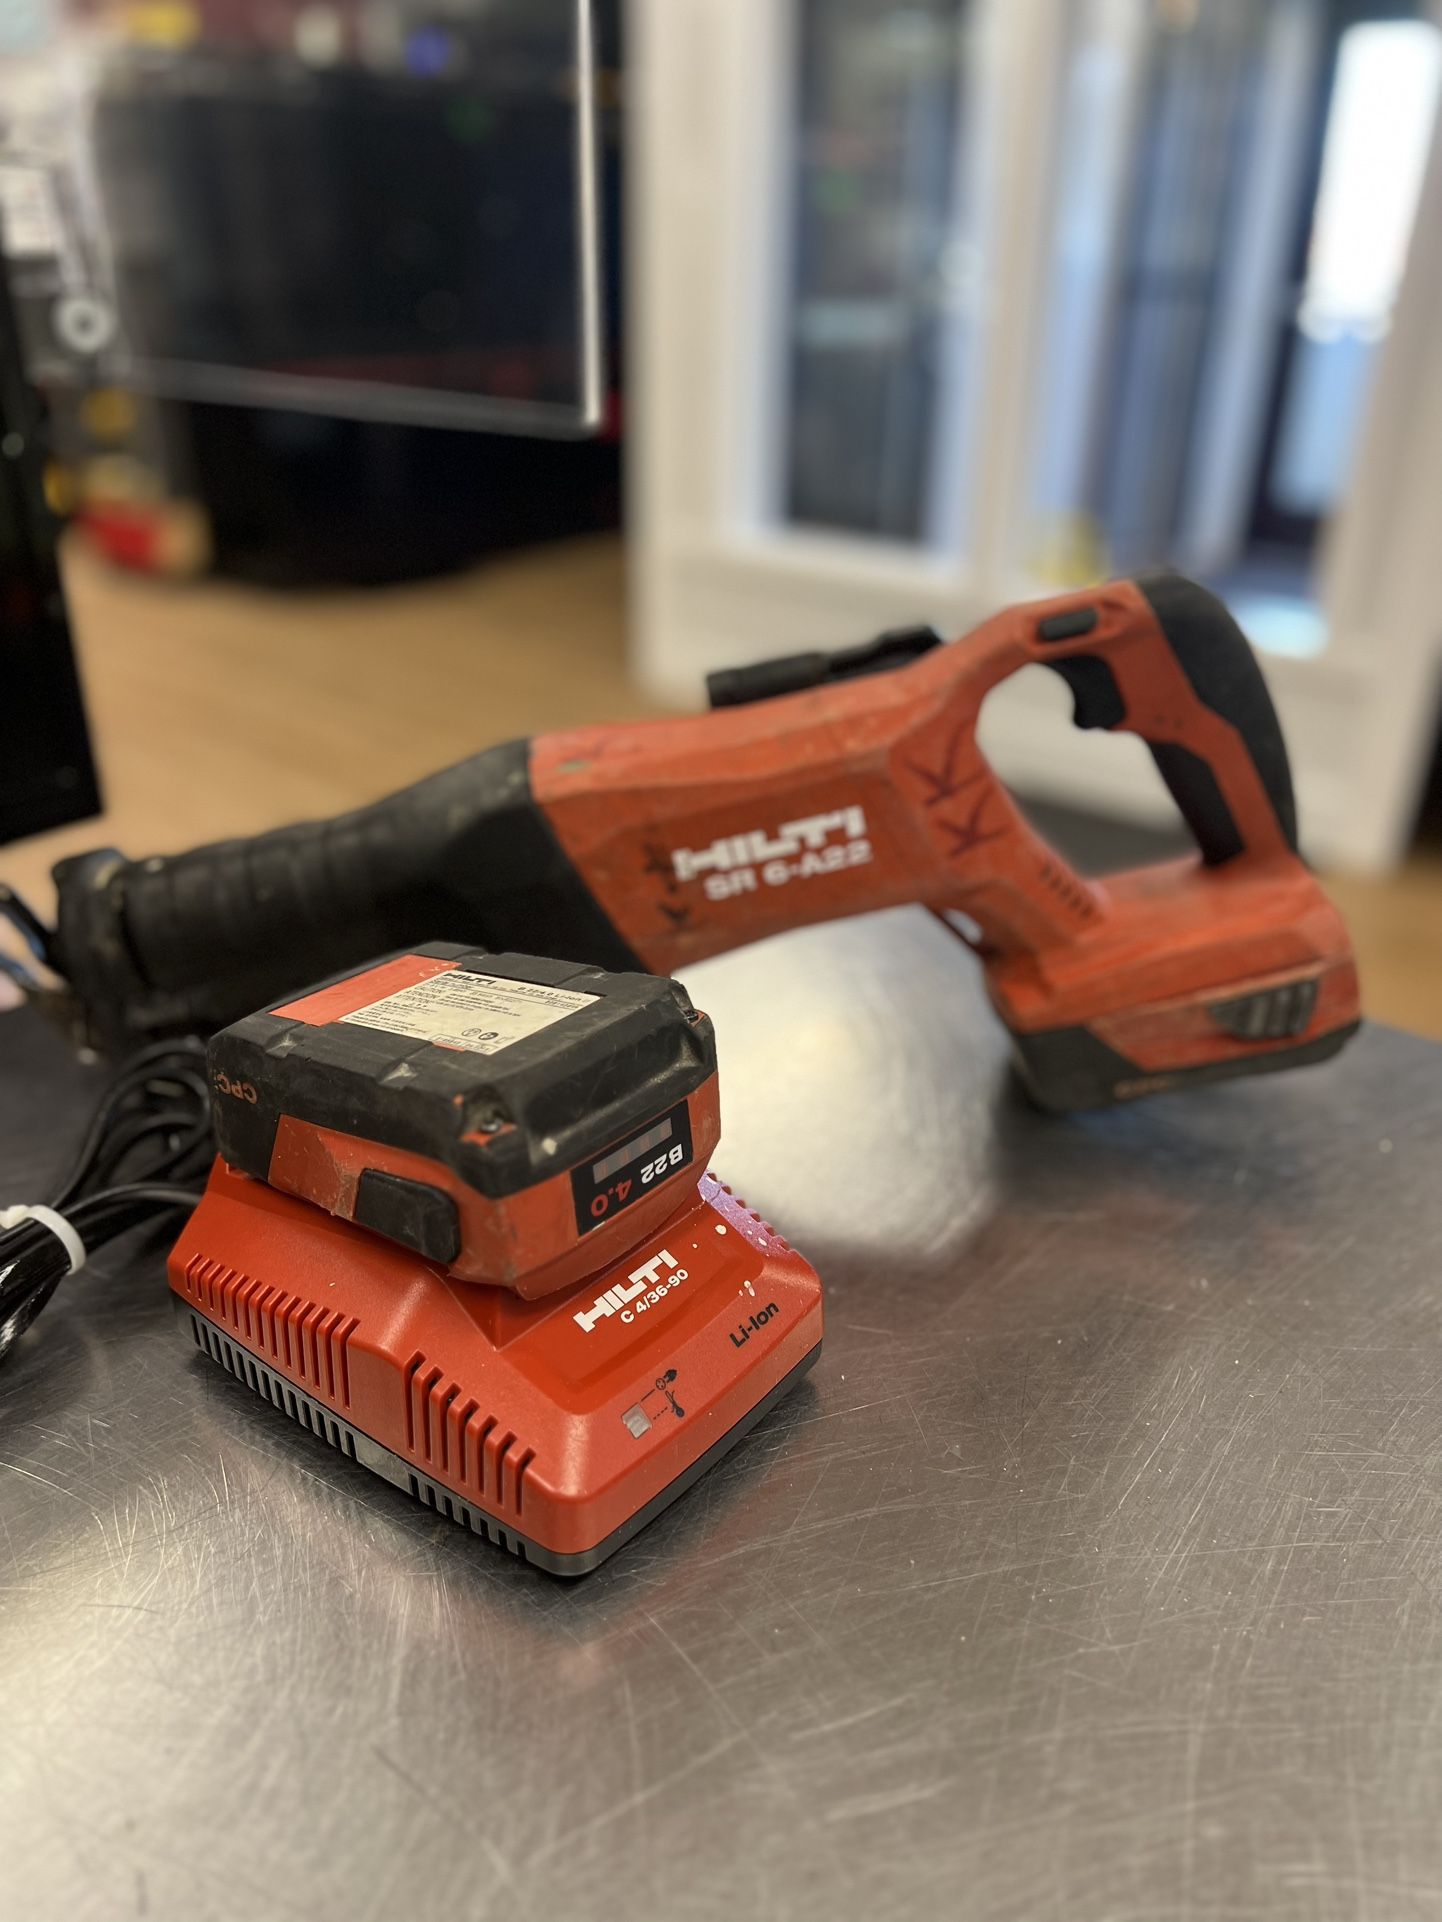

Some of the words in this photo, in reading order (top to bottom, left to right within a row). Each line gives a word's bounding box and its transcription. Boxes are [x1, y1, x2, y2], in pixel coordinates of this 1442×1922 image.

[672, 805, 867, 881] HILTI
[703, 867, 757, 900] SR
[762, 839, 873, 885] 6-A22
[443, 973, 497, 985] HILTI
[641, 1143, 683, 1184] B22
[591, 1179, 632, 1217] 4.0
[573, 1249, 679, 1333] HILTI
[620, 1309, 635, 1324] C
[636, 1268, 689, 1315] 4/36-90
[729, 1301, 780, 1348] Li-Ion
